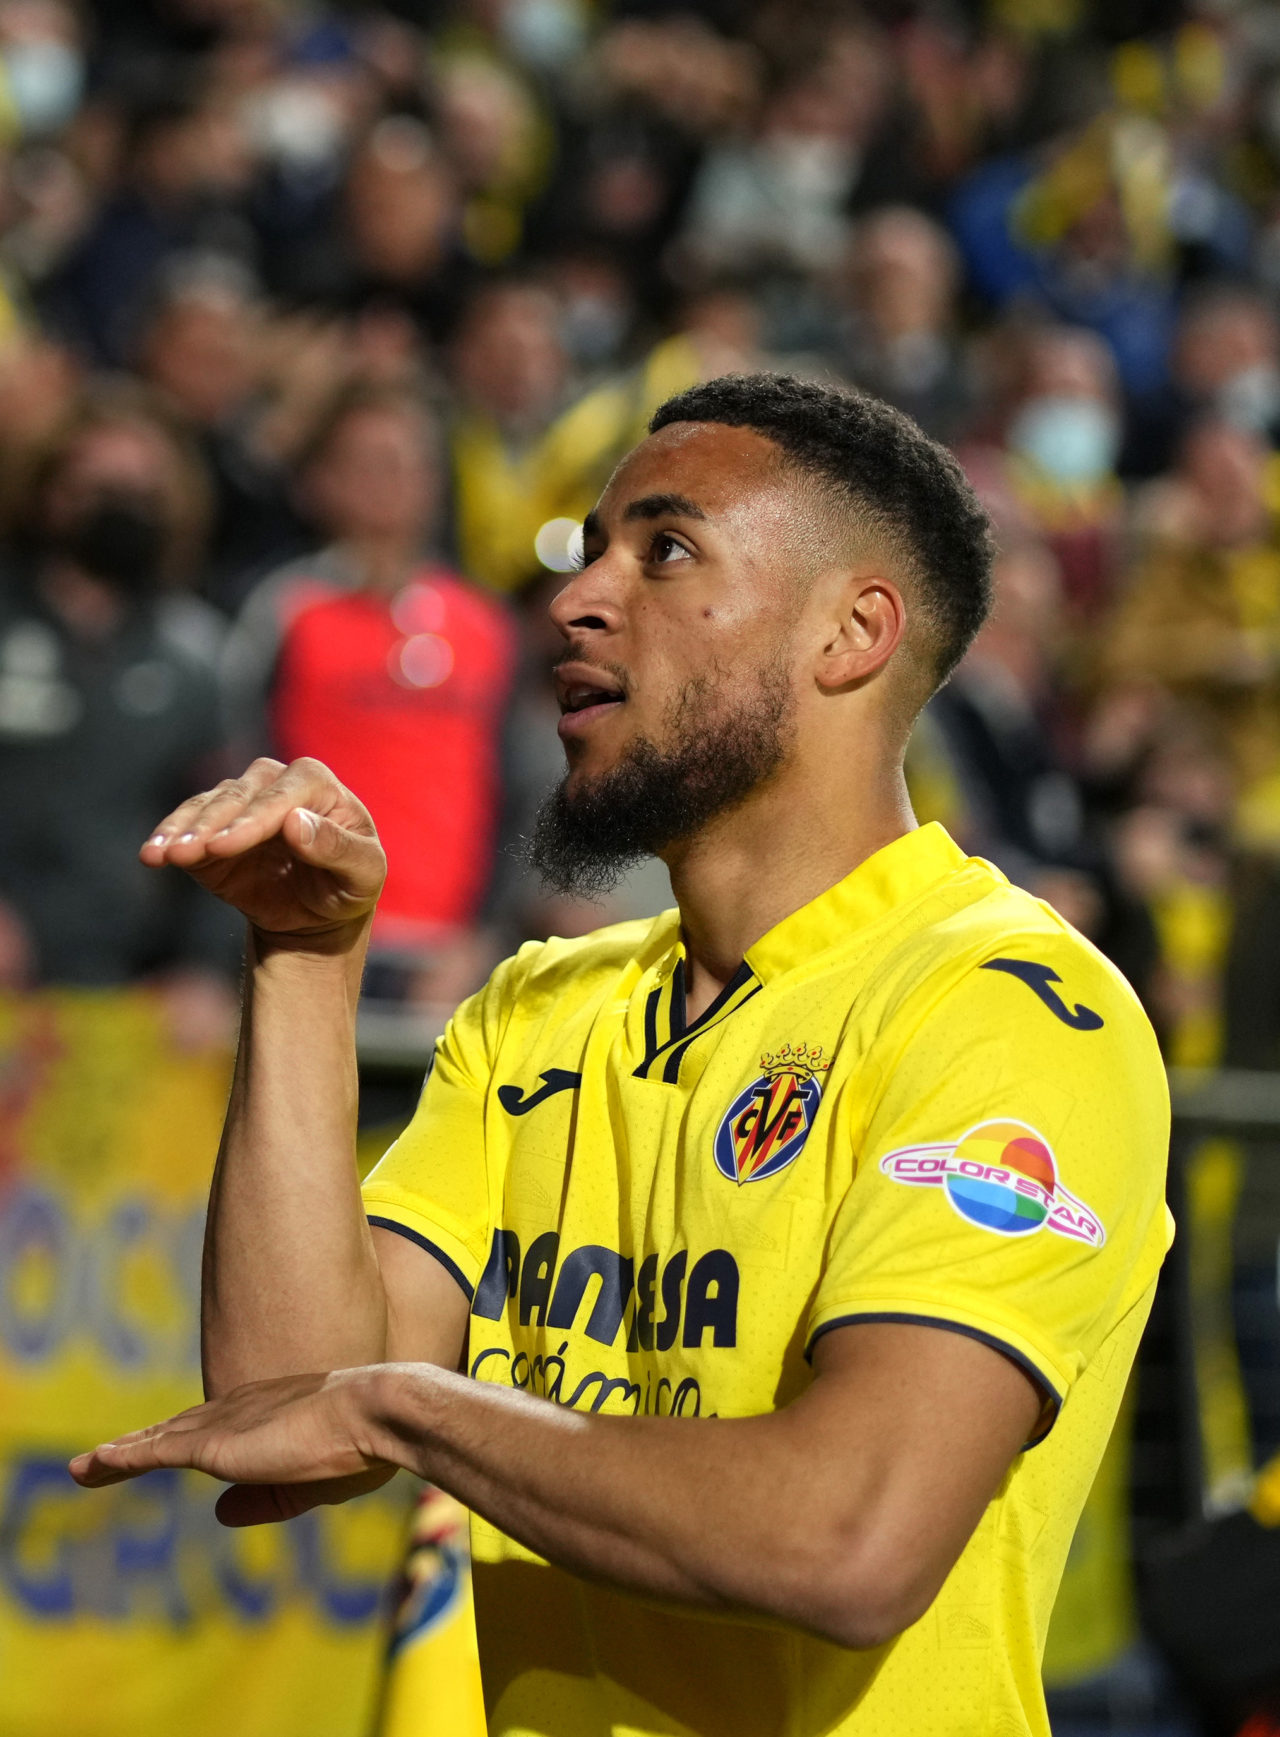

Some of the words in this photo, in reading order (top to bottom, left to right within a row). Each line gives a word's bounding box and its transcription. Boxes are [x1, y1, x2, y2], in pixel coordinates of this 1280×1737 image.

[894, 1158, 1011, 1185] COLOR
[1014, 1177, 1098, 1240] STAR
[471, 1227, 740, 1353] PAMESA
